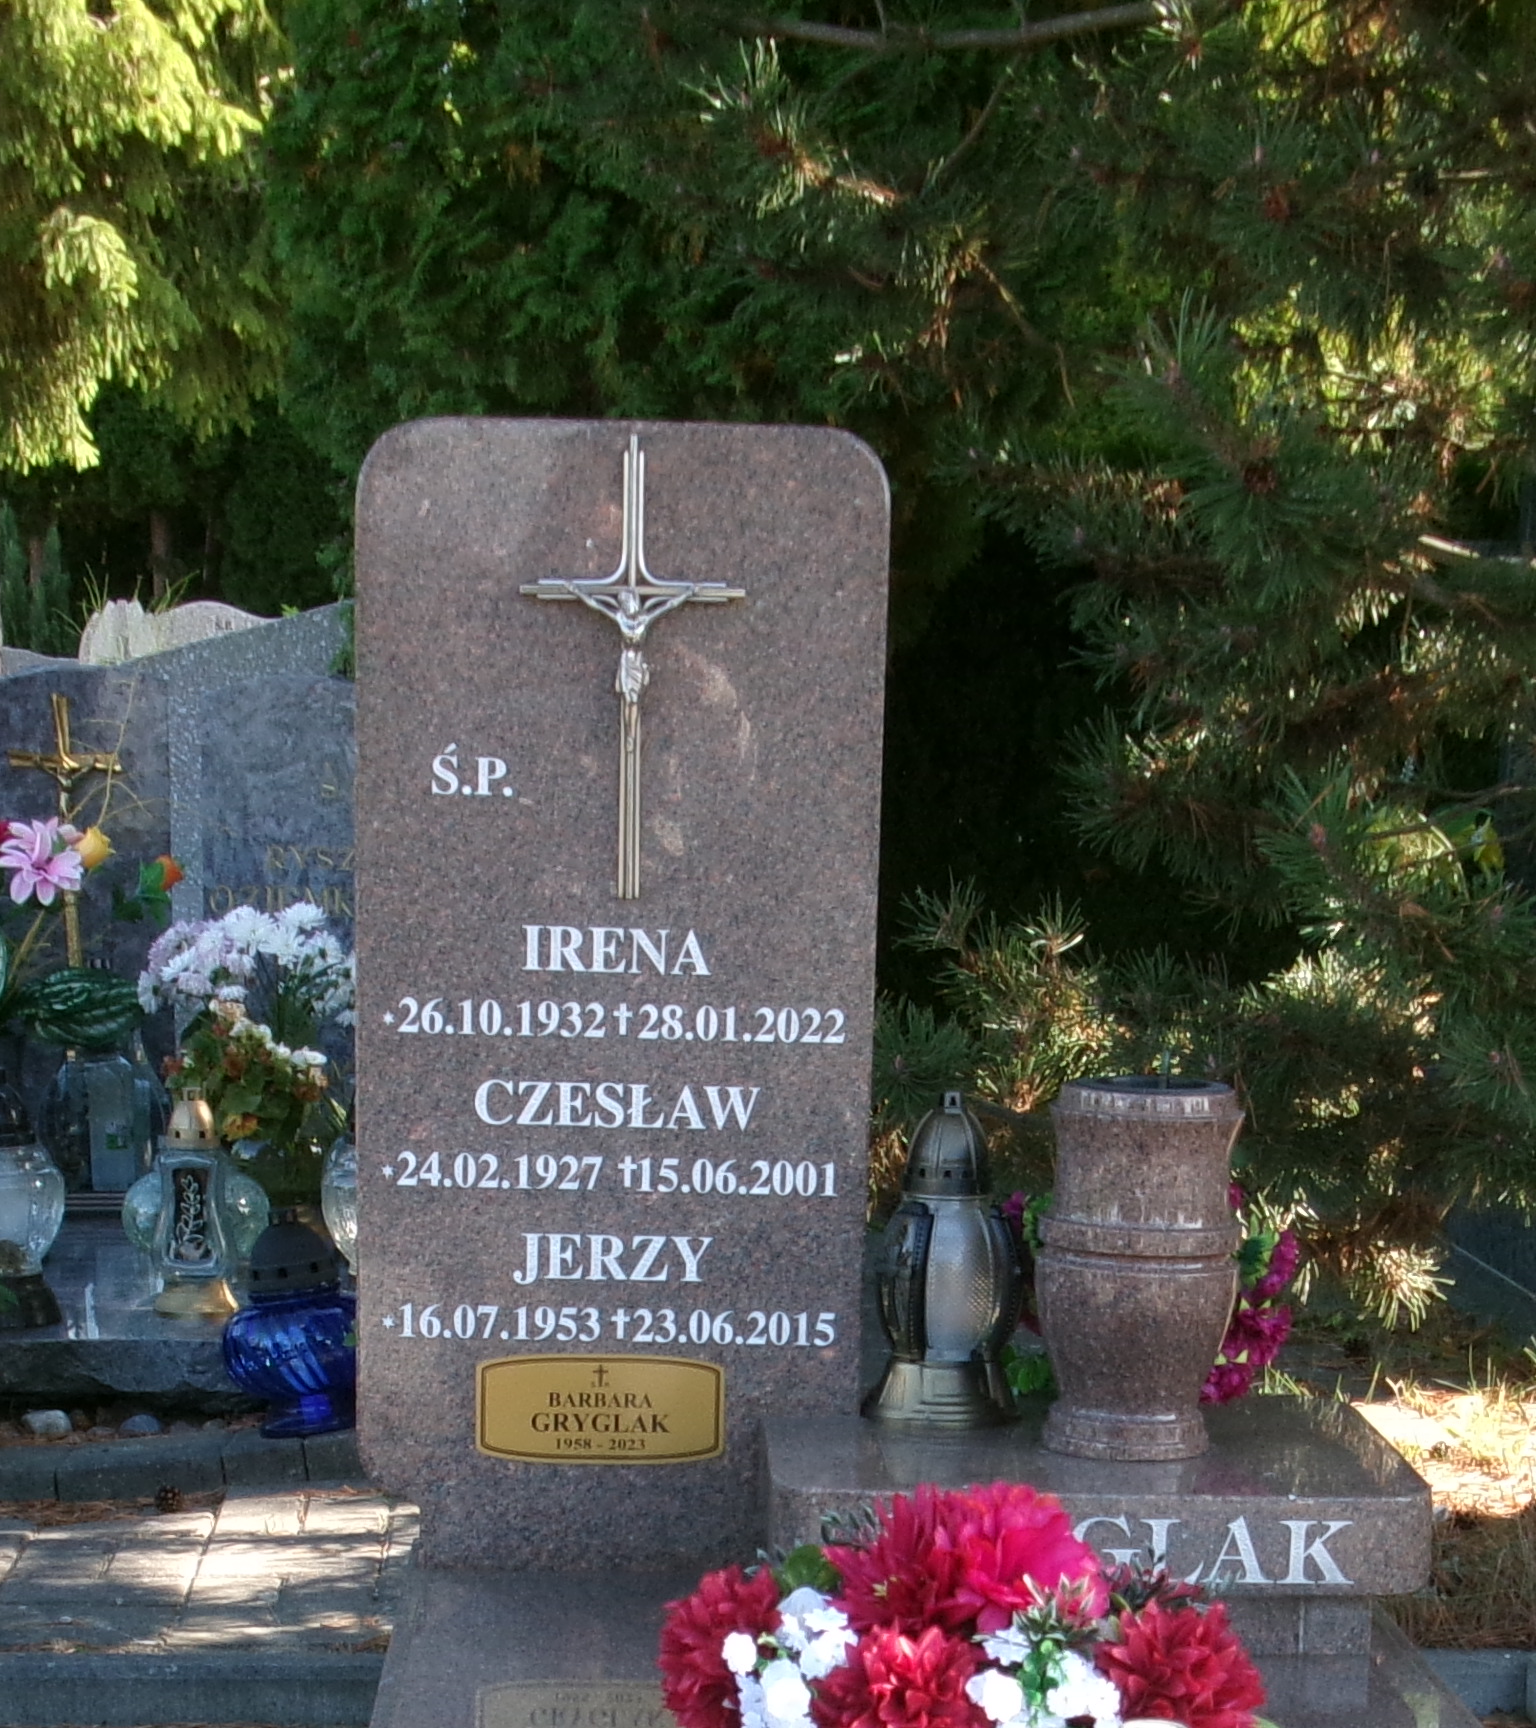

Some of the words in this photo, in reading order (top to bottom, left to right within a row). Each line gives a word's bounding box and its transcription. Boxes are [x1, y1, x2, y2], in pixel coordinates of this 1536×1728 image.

[430, 743, 514, 797] Ś.P.
[266, 845, 355, 871] RYSZ
[521, 923, 712, 977] IRENA
[474, 1078, 761, 1132] CZESŁAW
[513, 1232, 714, 1287] JERZY
[530, 1412, 671, 1434] GRYGLAK
[548, 1391, 653, 1409] BARBARA
[608, 1438, 646, 1451] 2023
[1072, 1515, 1355, 1586] GLAK
